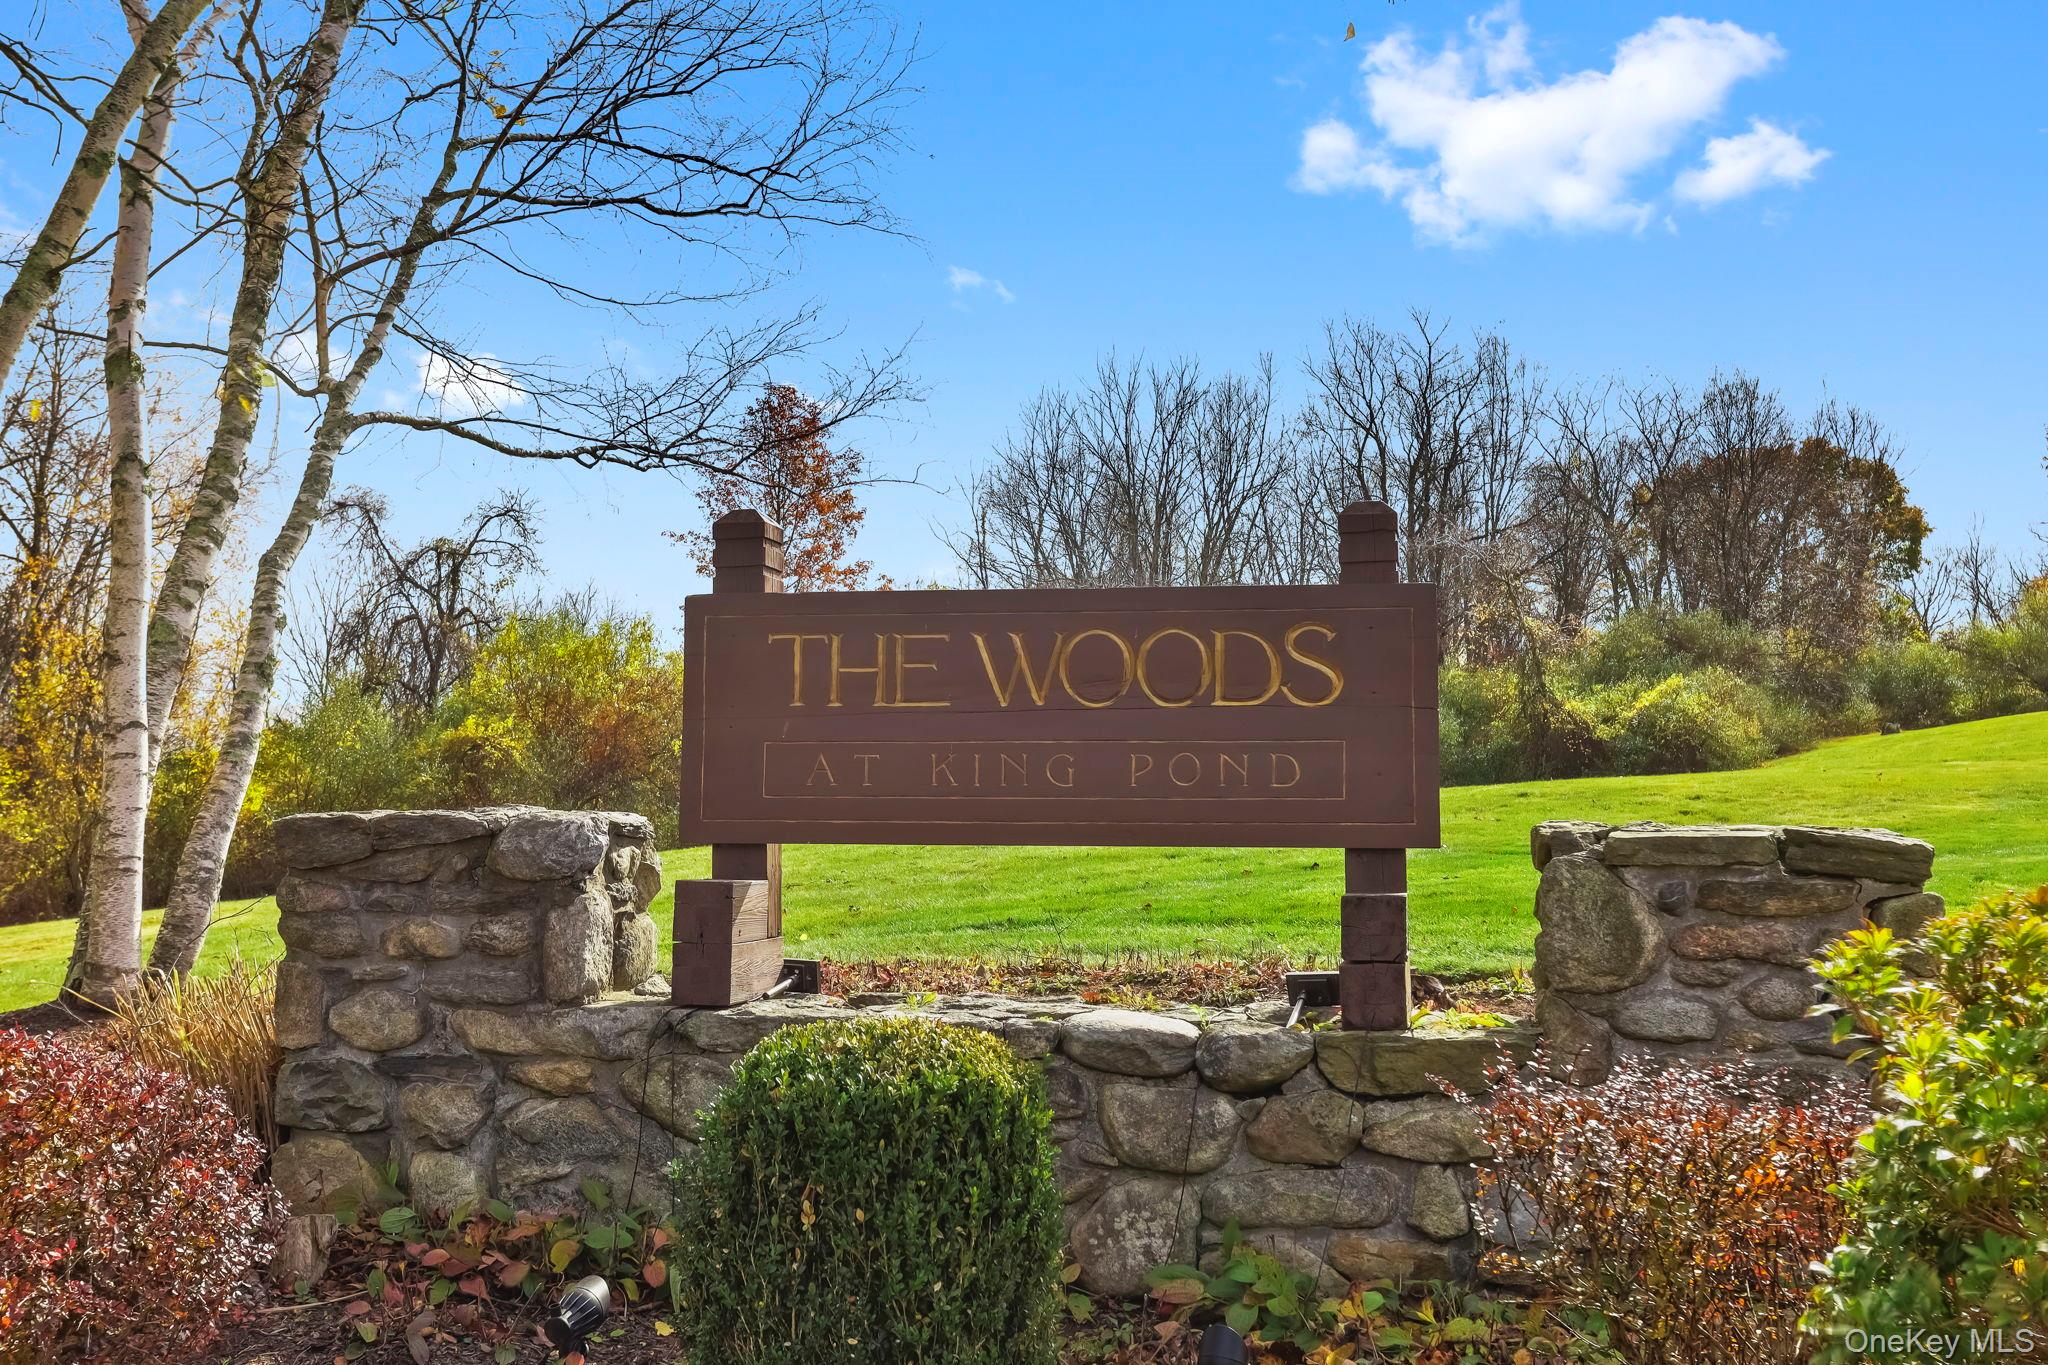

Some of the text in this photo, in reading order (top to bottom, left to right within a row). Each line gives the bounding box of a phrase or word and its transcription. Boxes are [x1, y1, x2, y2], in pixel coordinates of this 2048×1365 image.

[768, 621, 1346, 708] THE WOODS
[805, 752, 1302, 788] AT KING POND
